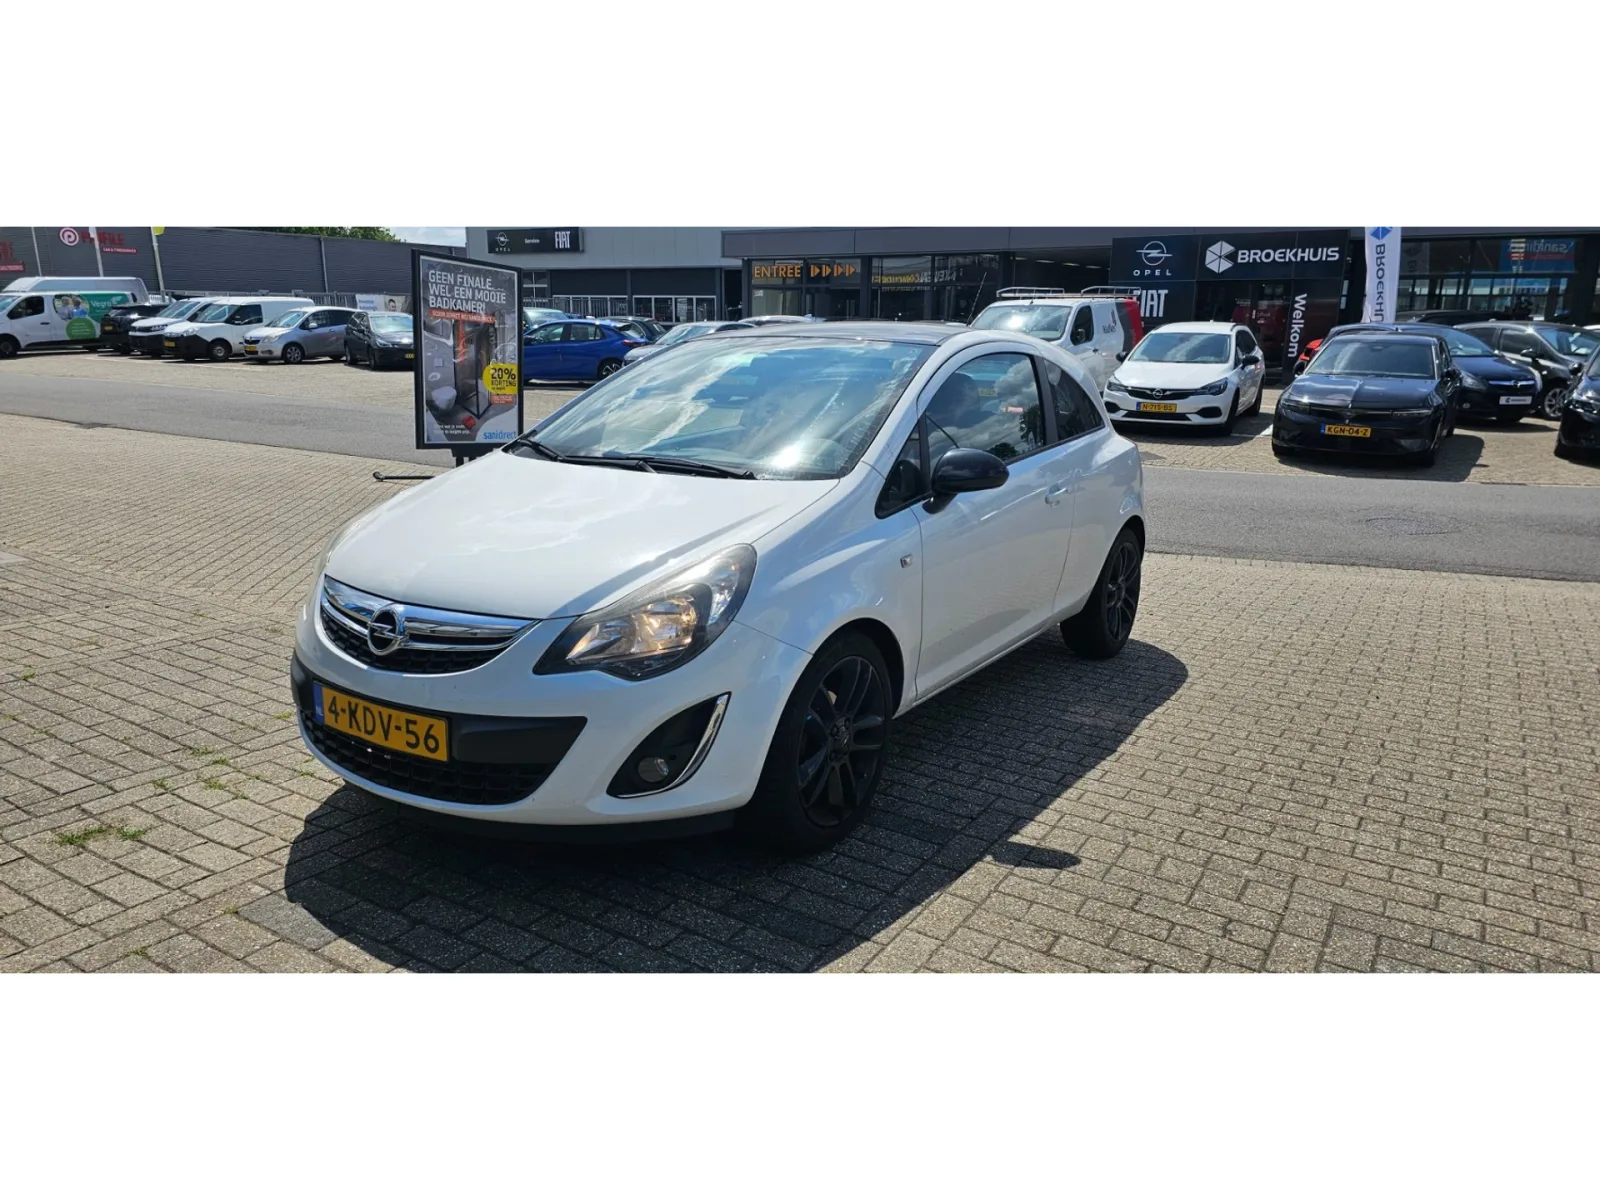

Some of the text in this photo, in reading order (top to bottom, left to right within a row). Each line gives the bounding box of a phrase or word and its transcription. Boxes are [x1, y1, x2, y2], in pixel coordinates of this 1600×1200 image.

[554, 231, 571, 248] FIAT
[1237, 247, 1340, 264] BROEKHUIS
[428, 270, 454, 285] GEEN
[754, 264, 801, 278] ENTREE
[428, 283, 506, 304] WEL EEN MOOIE
[91, 300, 112, 308] Vegro
[429, 296, 486, 313] BADKAMER!
[1287, 293, 1308, 357] Welkom
[491, 367, 516, 380] 20%
[483, 430, 516, 440] sanidirect
[1327, 426, 1369, 436] KGN-04-Z
[328, 696, 440, 754] 4-KDV-56
